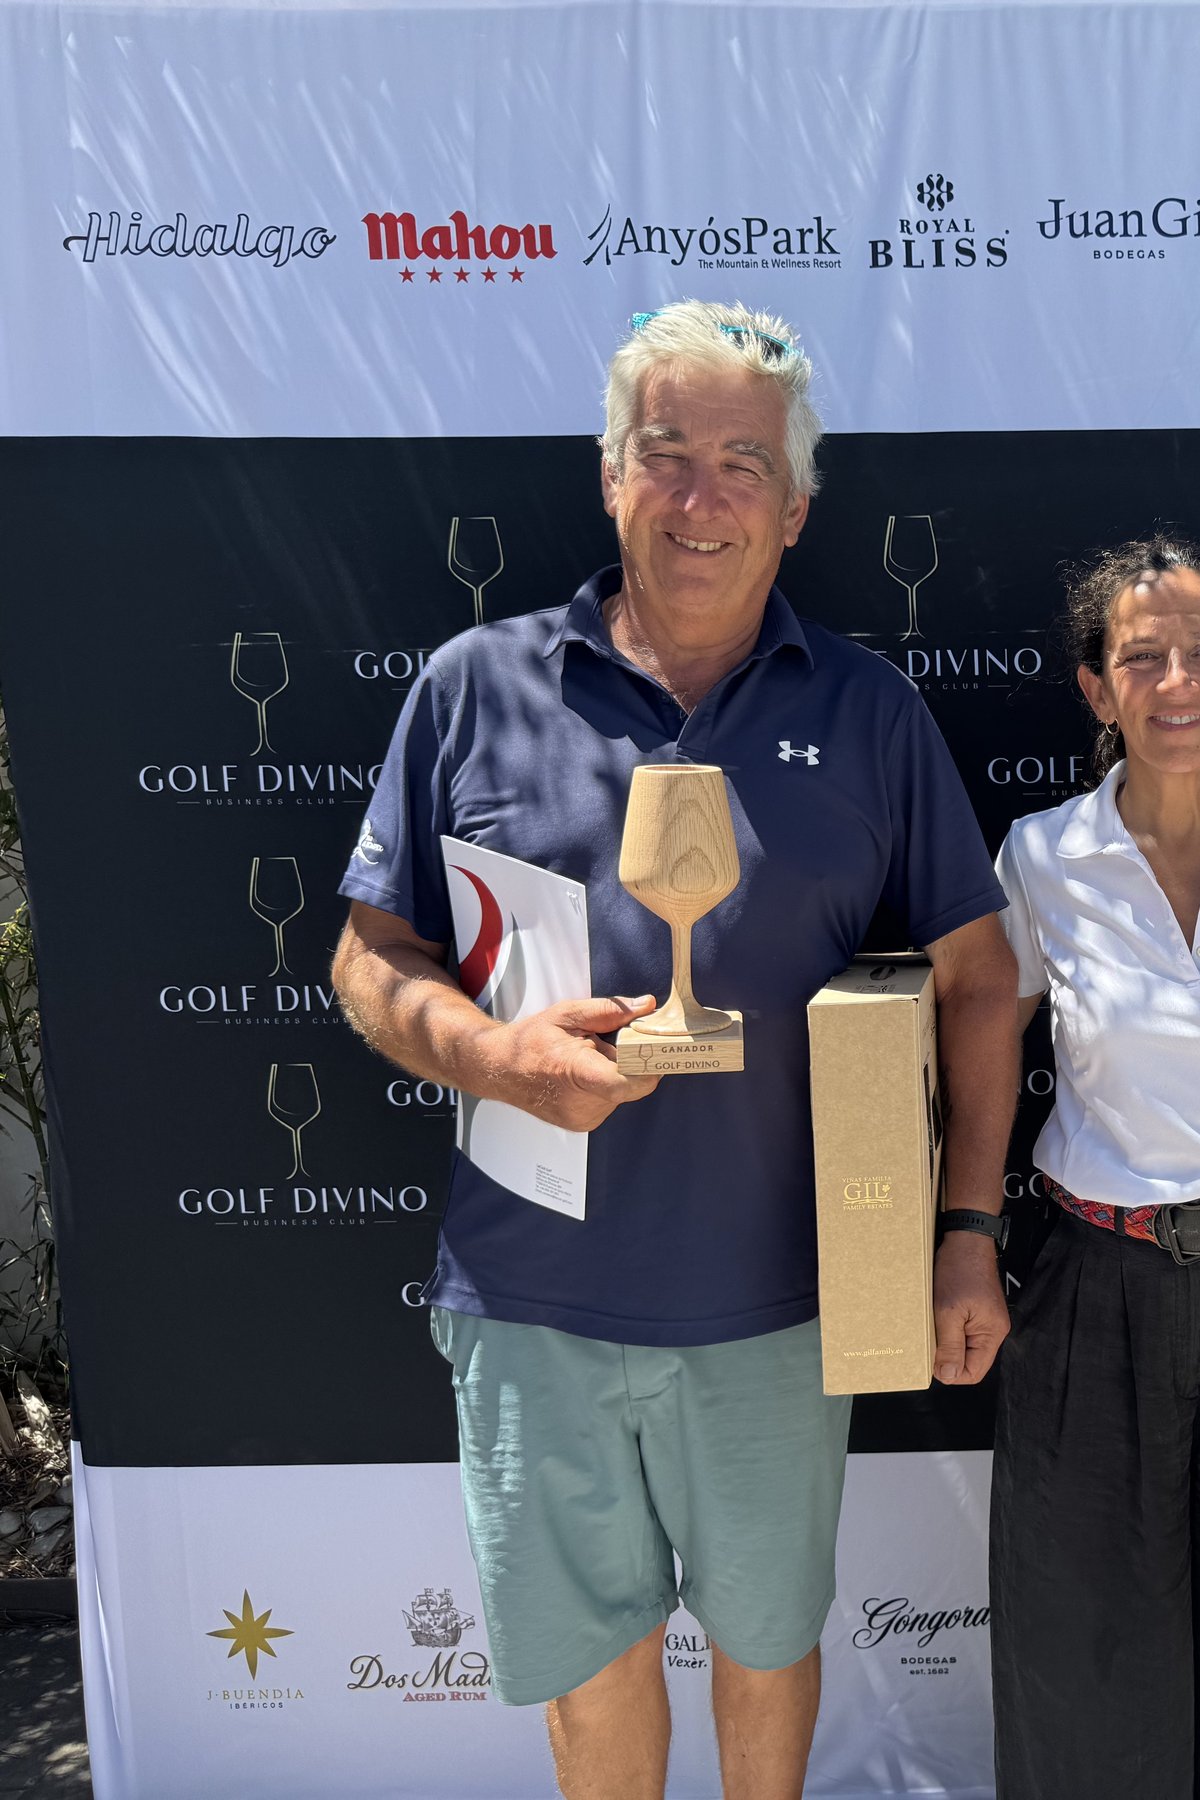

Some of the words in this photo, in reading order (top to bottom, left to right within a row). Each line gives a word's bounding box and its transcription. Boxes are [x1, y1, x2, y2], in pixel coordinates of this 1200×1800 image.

[361, 210, 559, 261] Mahou
[899, 218, 975, 236] ROYAL
[62, 211, 337, 268] Hidalgo
[868, 237, 1008, 269] BLISS
[1093, 249, 1165, 260] BODEGAS
[698, 258, 714, 269] The
[716, 258, 758, 269] Mountain
[761, 258, 769, 269] &
[771, 258, 811, 269] Wellness
[813, 258, 842, 269] Resort
[905, 647, 1042, 678] DIVINO
[942, 682, 979, 690] CLUB
[138, 765, 238, 793] GOLF
[987, 755, 1084, 785] GOLF
[206, 798, 284, 806] BUSINESS
[296, 797, 335, 805] CLUB
[159, 985, 257, 1013] GOLF
[276, 985, 336, 1012] DIV
[224, 1017, 301, 1025] BUSINESS
[661, 1045, 714, 1053] GANADOR
[655, 1062, 682, 1070] GOLF
[685, 1060, 720, 1069] DIVINO
[178, 1187, 274, 1215] GOLF
[293, 1185, 428, 1214] DIVINO
[843, 1182, 889, 1201] GIL
[243, 1218, 318, 1227] BUSINESS
[852, 1597, 990, 1650] Góngora
[667, 1655, 708, 1669] Vexèr.
[900, 1656, 957, 1665] BODEGAS
[346, 1654, 409, 1690] Dos
[229, 1701, 284, 1710] IBÉRICOS
